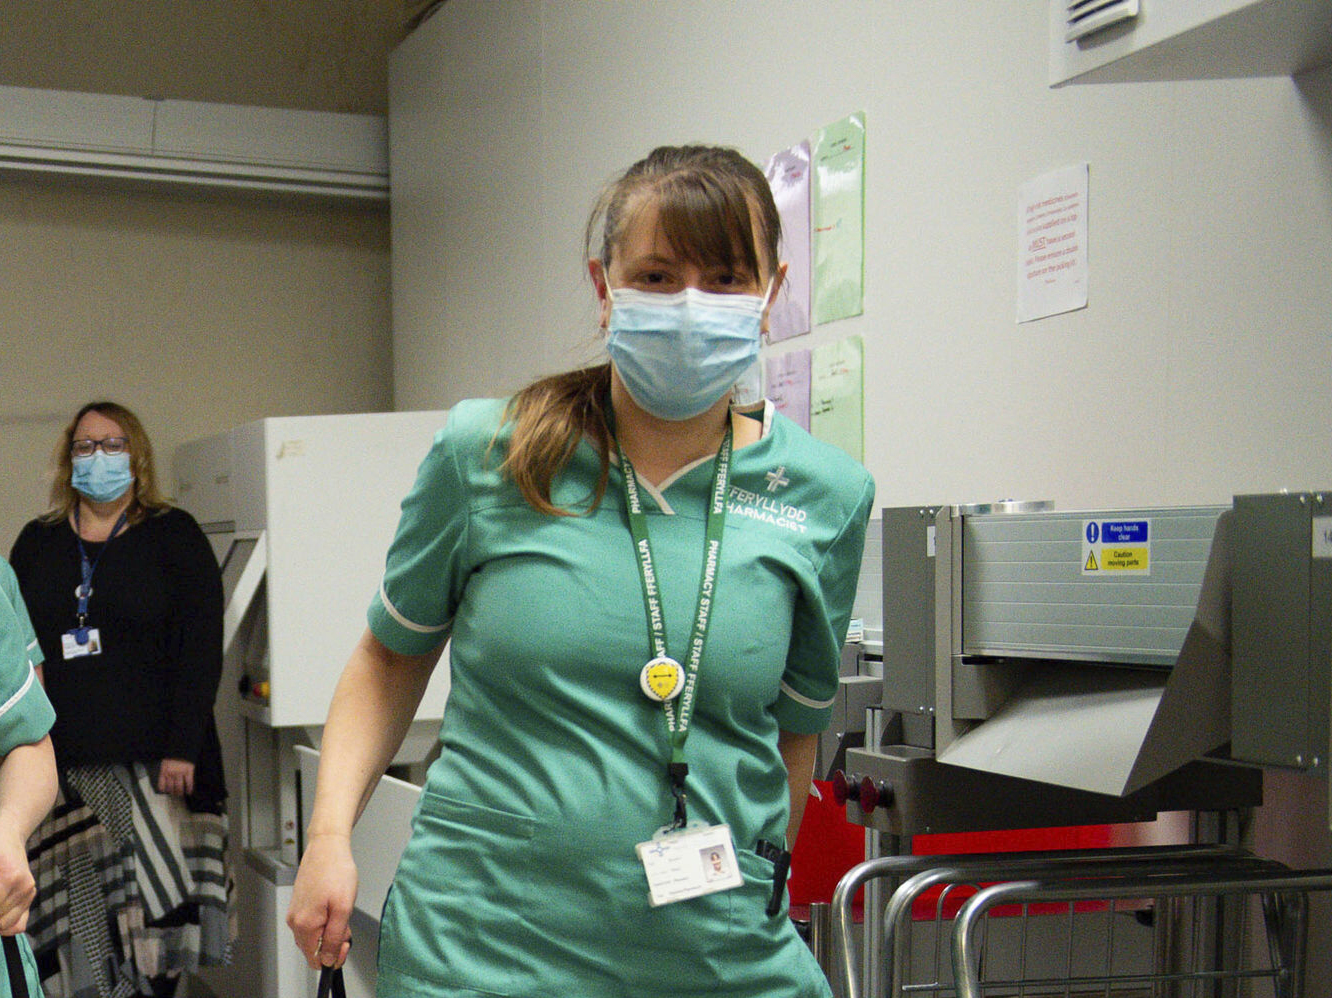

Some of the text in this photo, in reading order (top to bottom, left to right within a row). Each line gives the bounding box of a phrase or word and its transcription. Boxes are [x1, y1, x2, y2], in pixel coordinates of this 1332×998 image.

[726, 500, 808, 533] HARMACIST
[1124, 524, 1139, 532] hands
[638, 538, 658, 597] FFERYLLFA
[702, 540, 719, 597] PHARMACY
[1107, 559, 1139, 568] moving parts
[648, 597, 663, 631] STAFF
[696, 598, 711, 632] STAFF
[689, 638, 704, 672] STAFF
[678, 673, 697, 733] FFERYLLFA
